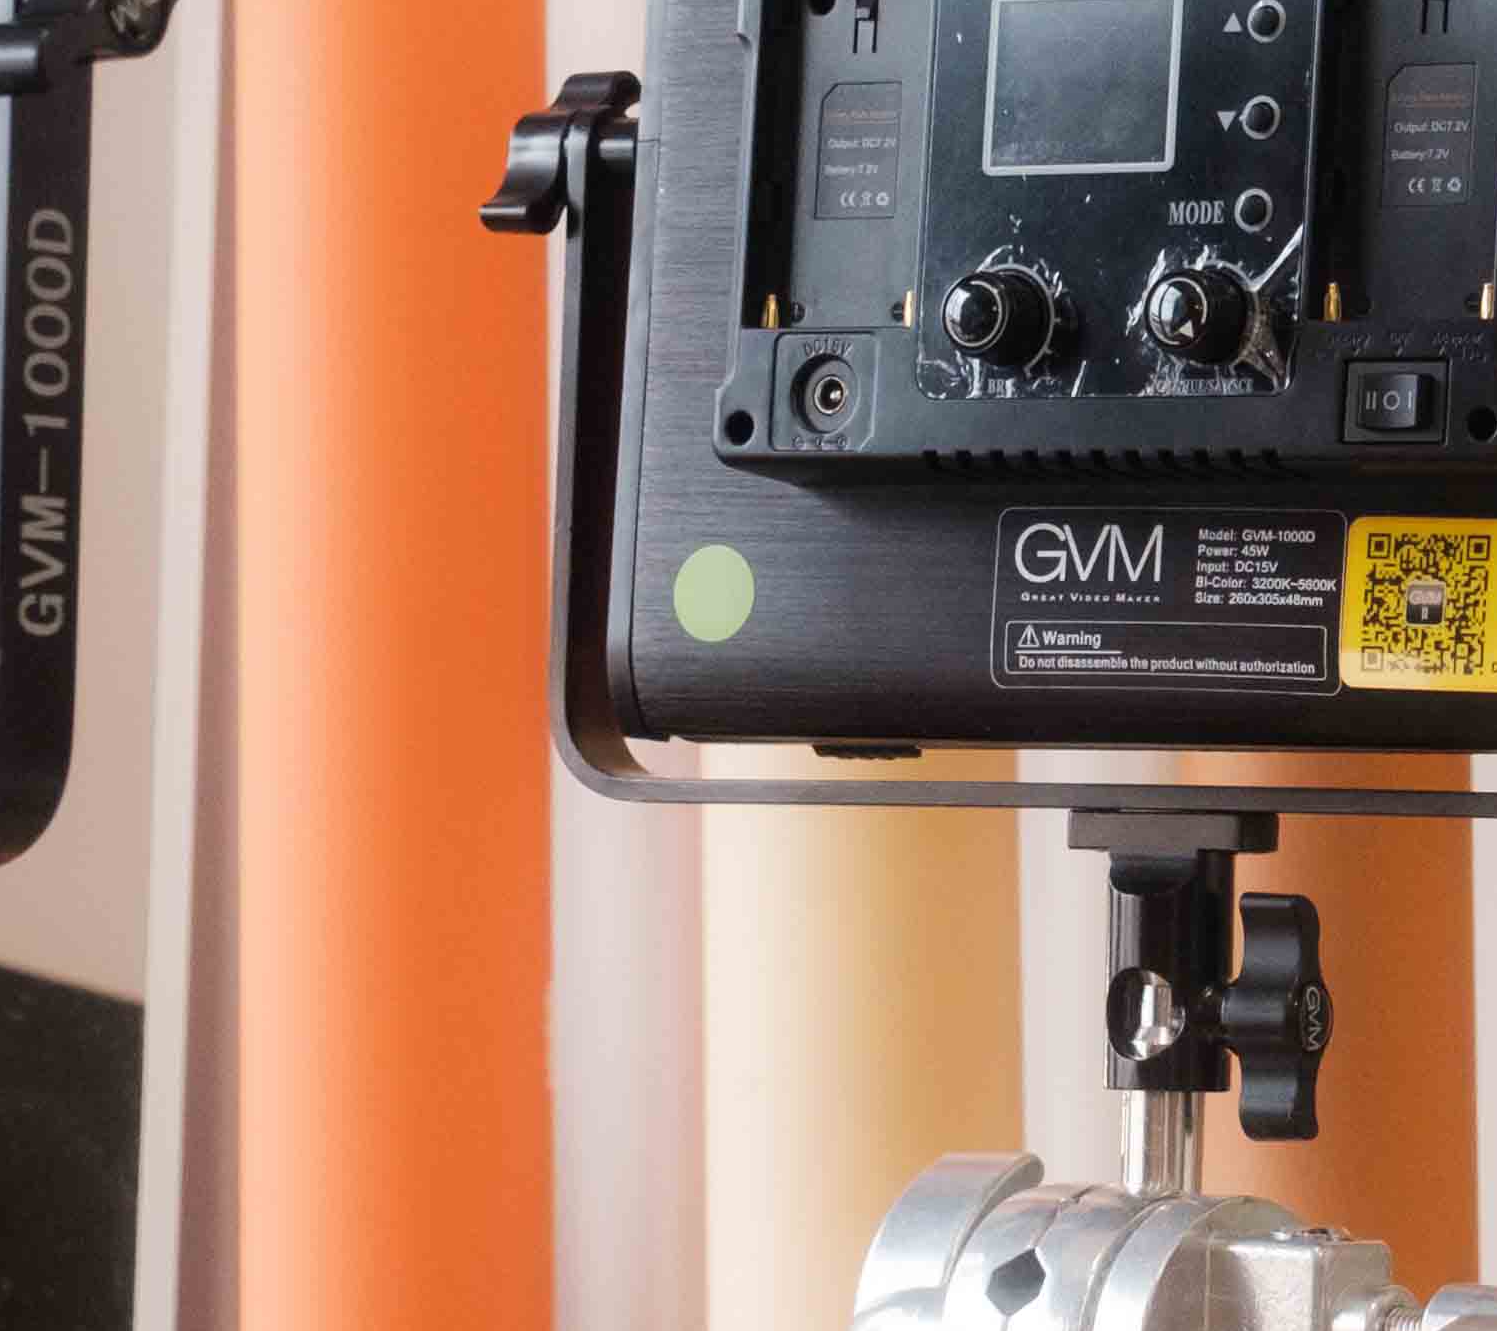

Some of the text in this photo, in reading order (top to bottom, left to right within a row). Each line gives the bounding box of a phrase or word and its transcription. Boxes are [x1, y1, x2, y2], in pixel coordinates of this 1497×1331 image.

[1168, 201, 1225, 226] MODE
[18, 208, 74, 637] GVM-1000D
[1198, 529, 1316, 544] Model: GVM-1000D
[1014, 523, 1164, 583] GVM
[1198, 544, 1270, 558] Power: 45W
[1196, 560, 1278, 574] Input: DC15V
[1195, 576, 1247, 590] Bi-Color:
[1195, 591, 1224, 605] Size:
[1041, 631, 1102, 649] Warning
[1019, 656, 1316, 675] Do not disassemble the product without authorization
[1306, 986, 1322, 1051] GVM
